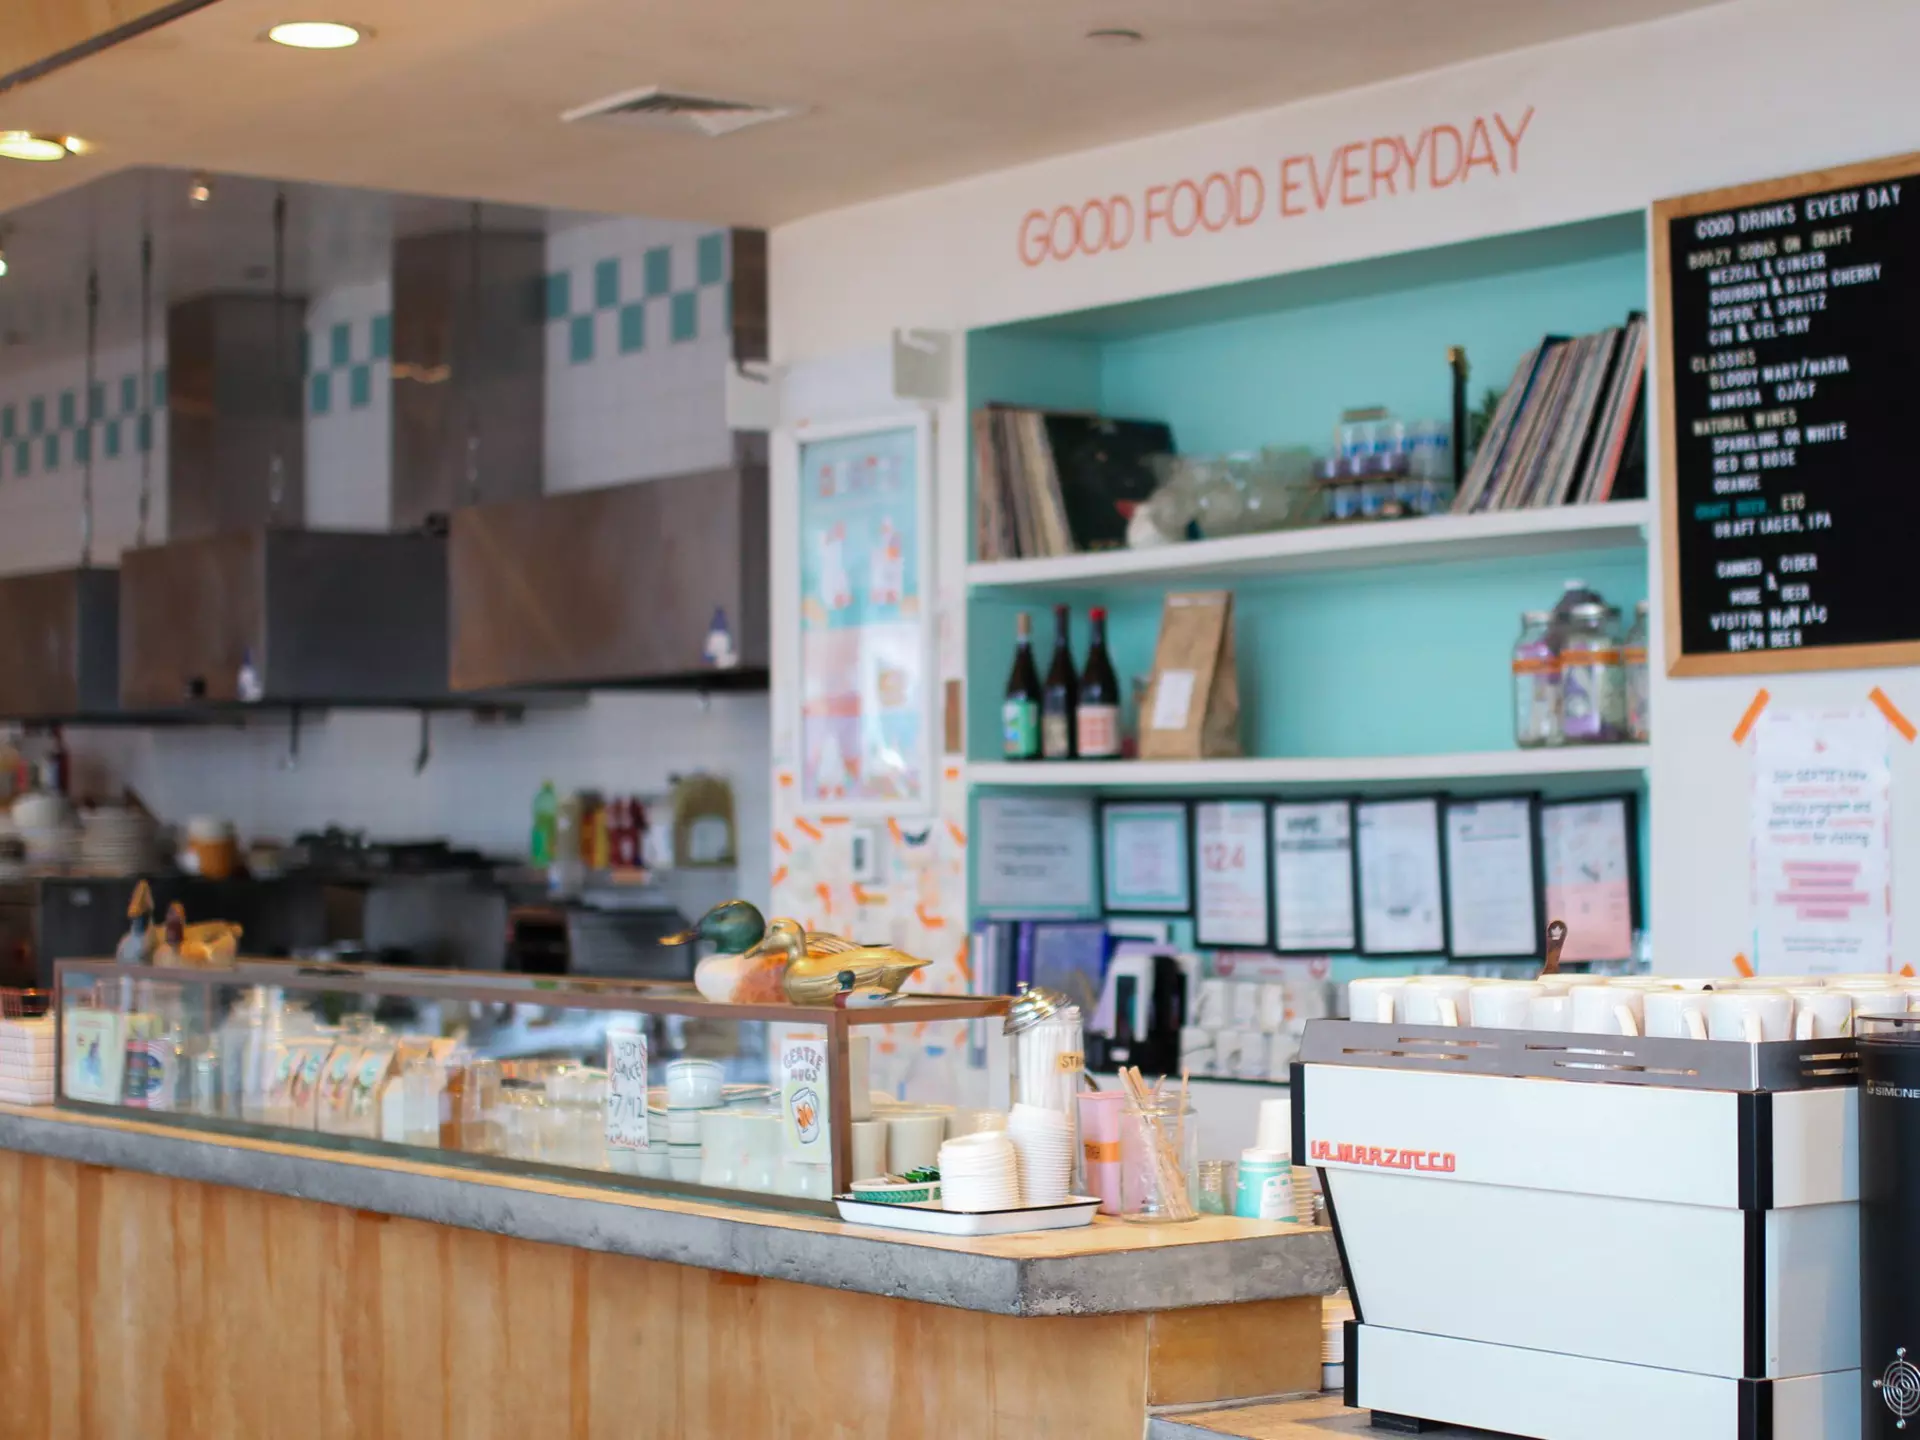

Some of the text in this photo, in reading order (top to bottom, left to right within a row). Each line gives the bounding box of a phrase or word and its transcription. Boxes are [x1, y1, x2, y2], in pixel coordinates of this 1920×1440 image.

[1016, 106, 1536, 268] GOOD FOOD EVERYDAY
[1696, 186, 1900, 240] GOOD DRINKS EVERY DAY
[1688, 227, 1852, 270] BOOZY SODAS ON DRAFT
[1709, 253, 1826, 286] MEZCAL & GINGER
[1710, 264, 1882, 306] BOURBON & BLACK CHERRY
[1763, 302, 1772, 318] &
[1778, 295, 1827, 316] SPRITZ
[1709, 318, 1810, 346] GIN & CEL-RAY
[1691, 350, 1756, 372] CLASSICS
[1710, 370, 1758, 390] BLOODY
[1710, 391, 1762, 411] MIMOSA
[1692, 410, 1797, 437] NATURAL WINES
[1712, 423, 1847, 454] SPARKLING OR WHITE
[1714, 451, 1796, 474] RED OR ROSE
[1714, 476, 1760, 494] ORANGE
[1781, 494, 1806, 512] ETC
[1714, 521, 1756, 539] DRAFT
[1808, 513, 1832, 530] IPA
[1716, 555, 1818, 579] CANNED CIDER
[1767, 573, 1778, 591] &
[1729, 585, 1810, 606] MORE BEER
[1710, 611, 1763, 632] VISITOR
[1770, 629, 1802, 648] BEER
[1337, 1142, 1456, 1172] MARZOCCO
